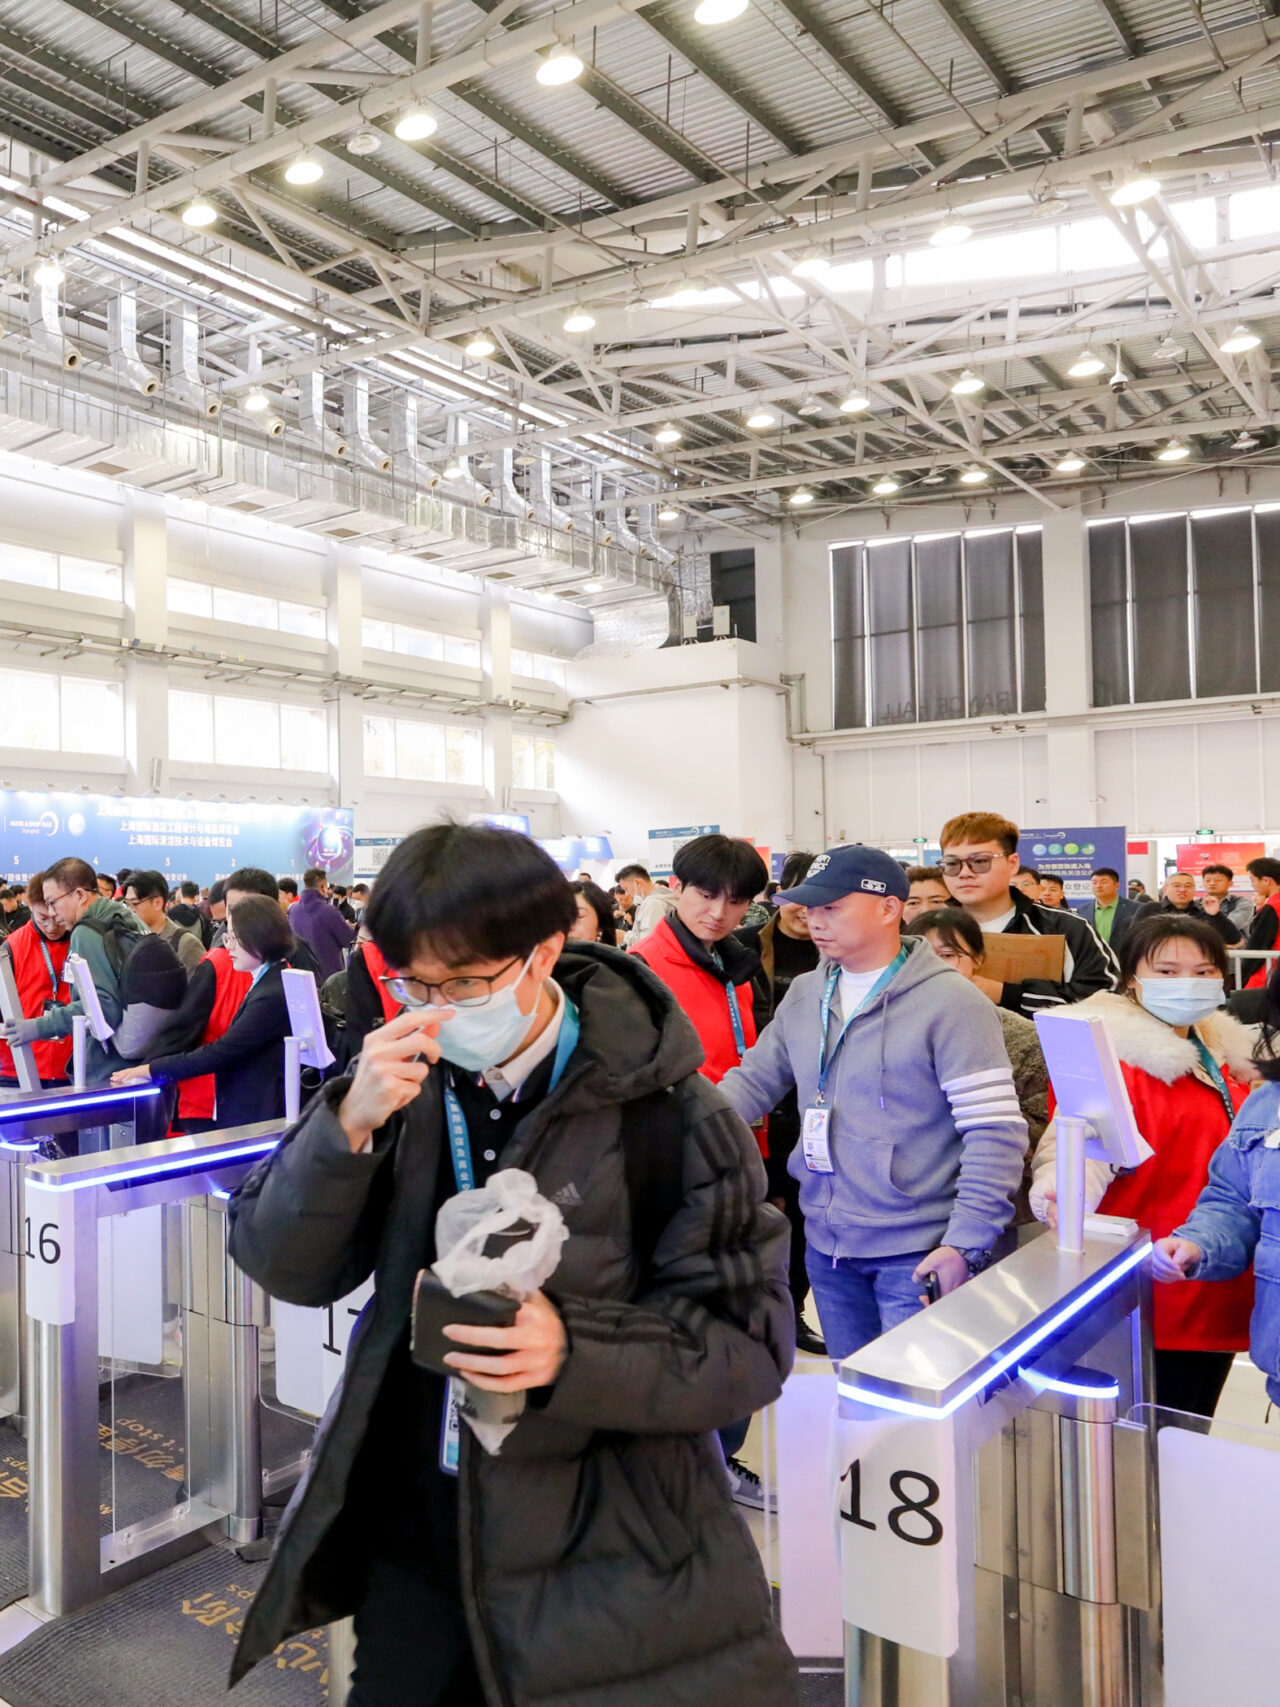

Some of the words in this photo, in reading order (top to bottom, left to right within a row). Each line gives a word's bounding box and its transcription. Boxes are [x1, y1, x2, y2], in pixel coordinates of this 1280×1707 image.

[13, 855, 20, 865] 5
[93, 856, 99, 865] 4
[165, 857, 171, 866] 3
[231, 858, 236, 867] 2
[290, 858, 294, 867] 1
[25, 1216, 61, 1264] 16
[116, 1417, 163, 1441] stop
[840, 1458, 945, 1546] 18
